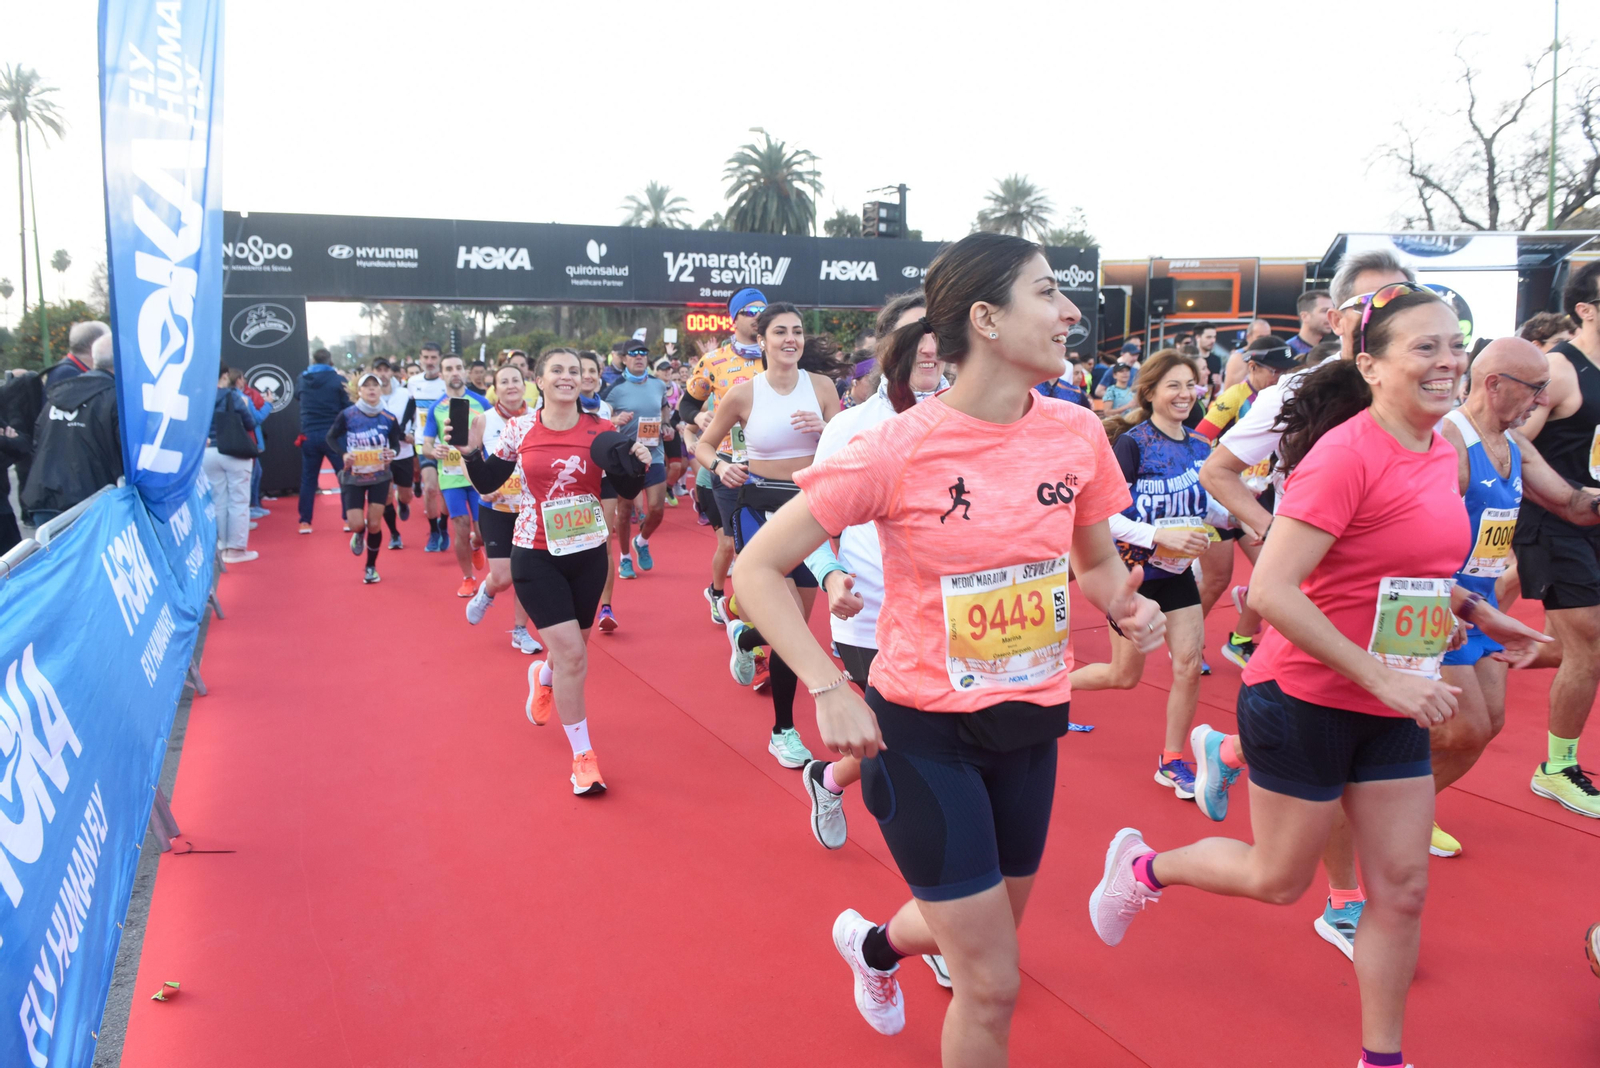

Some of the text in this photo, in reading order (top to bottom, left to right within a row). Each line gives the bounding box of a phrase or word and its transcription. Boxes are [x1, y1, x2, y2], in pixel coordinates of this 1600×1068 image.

[156, 0, 186, 124] HUMA
[128, 41, 156, 116] FLY
[356, 246, 419, 259] HYUNDAI
[456, 246, 533, 271] HOKA
[687, 251, 773, 270] maratón
[602, 279, 624, 287] Partner
[710, 266, 774, 285] sevilla
[820, 260, 879, 281] HOKA
[700, 287, 733, 297] 28 ener
[131, 138, 207, 474] HOKA
[1065, 473, 1079, 486] fit
[1136, 467, 1200, 495] MEDIO MARATÓN
[1037, 481, 1075, 506] GO
[553, 507, 592, 530] 9120
[101, 520, 159, 637] HOKA
[951, 560, 1057, 589] MEDIO MARATÓN SEVILLA
[968, 590, 1046, 641] 9443
[1395, 604, 1453, 638] 6190
[0, 642, 82, 909] OKA
[19, 779, 109, 1068] FLY HUMAN FLY
